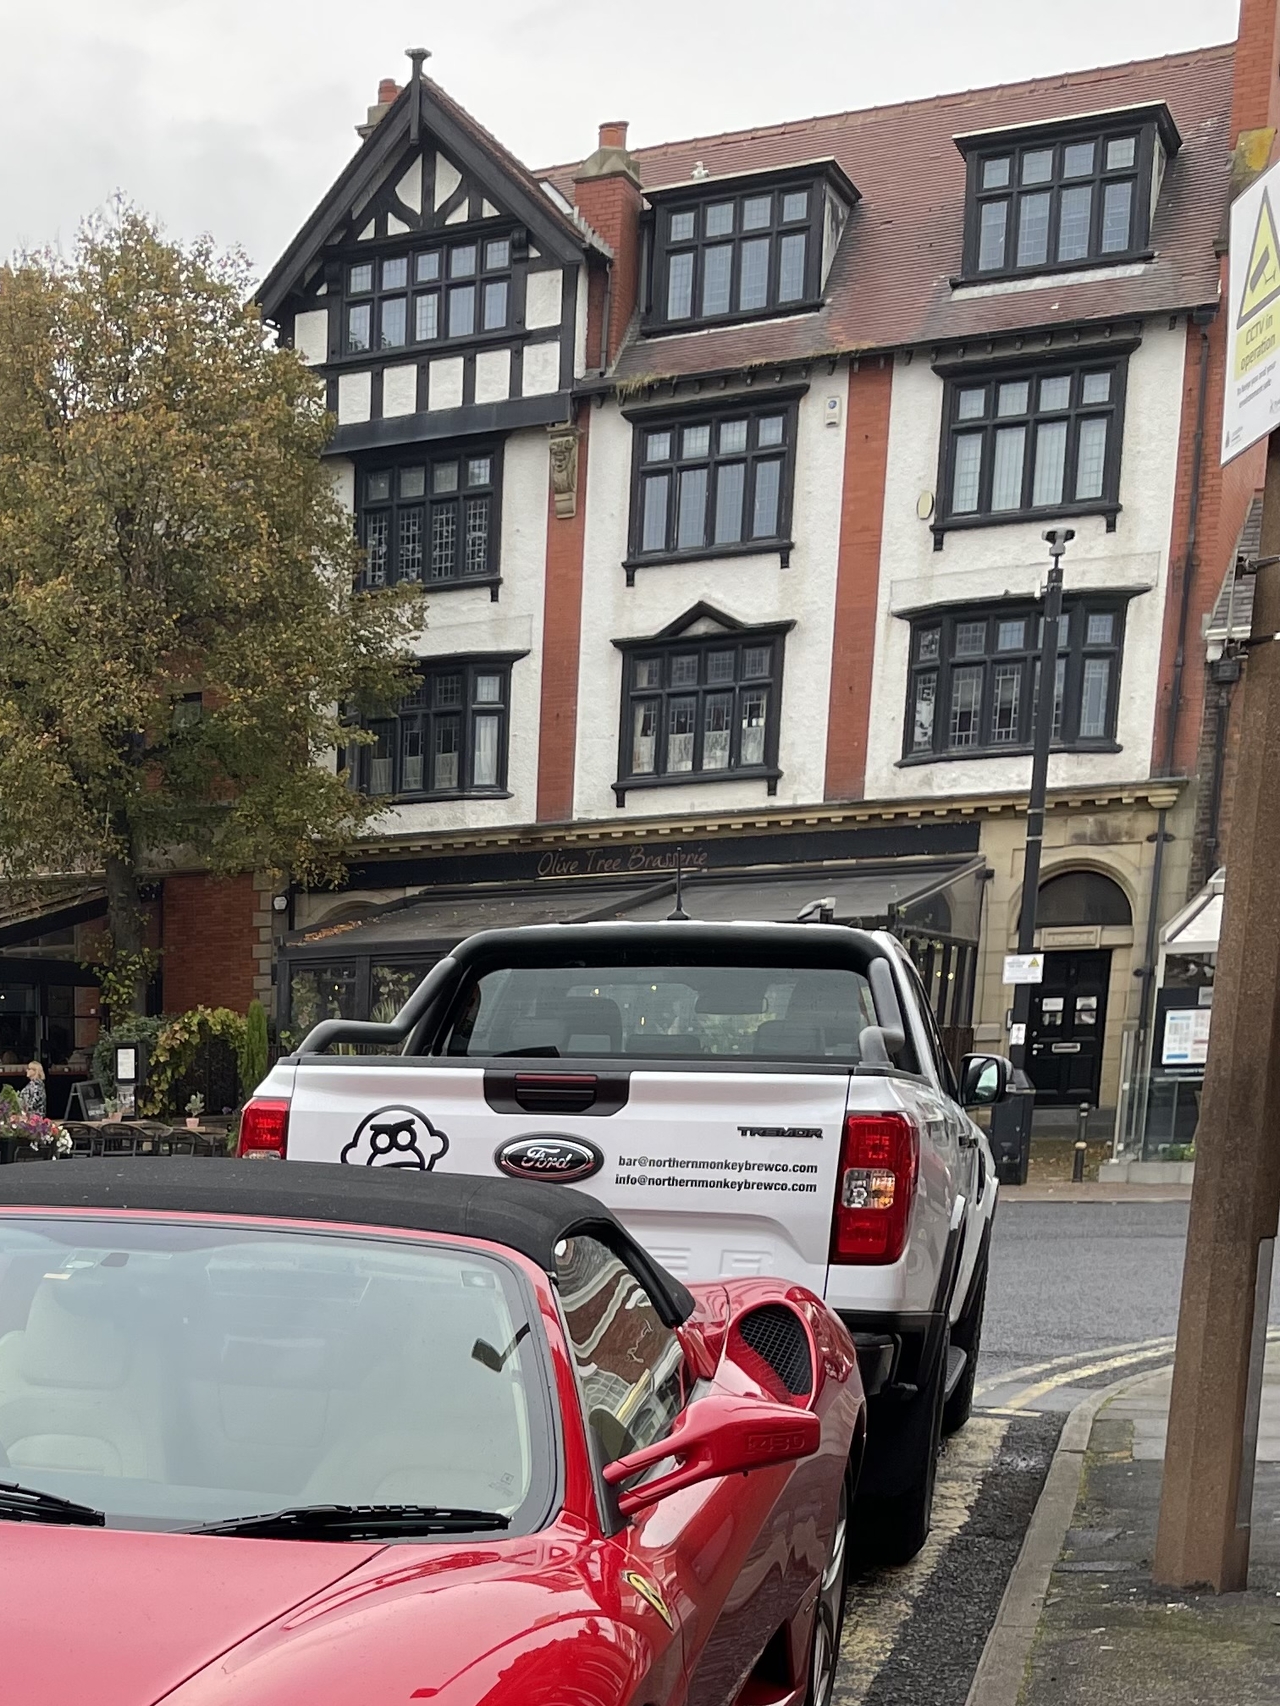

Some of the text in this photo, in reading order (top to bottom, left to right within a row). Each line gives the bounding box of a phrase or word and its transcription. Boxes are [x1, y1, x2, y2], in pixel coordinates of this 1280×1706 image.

[1246, 314, 1273, 345] CCTV in
[1240, 333, 1276, 372] operation
[537, 845, 708, 876] Olive Tree Brasserie
[737, 1126, 823, 1139] TREMOR
[521, 1146, 573, 1170] Ford
[618, 1155, 818, 1174] bar@northernmonkeybrewco.com
[615, 1174, 817, 1193] info@northernmonkeybrewco.com
